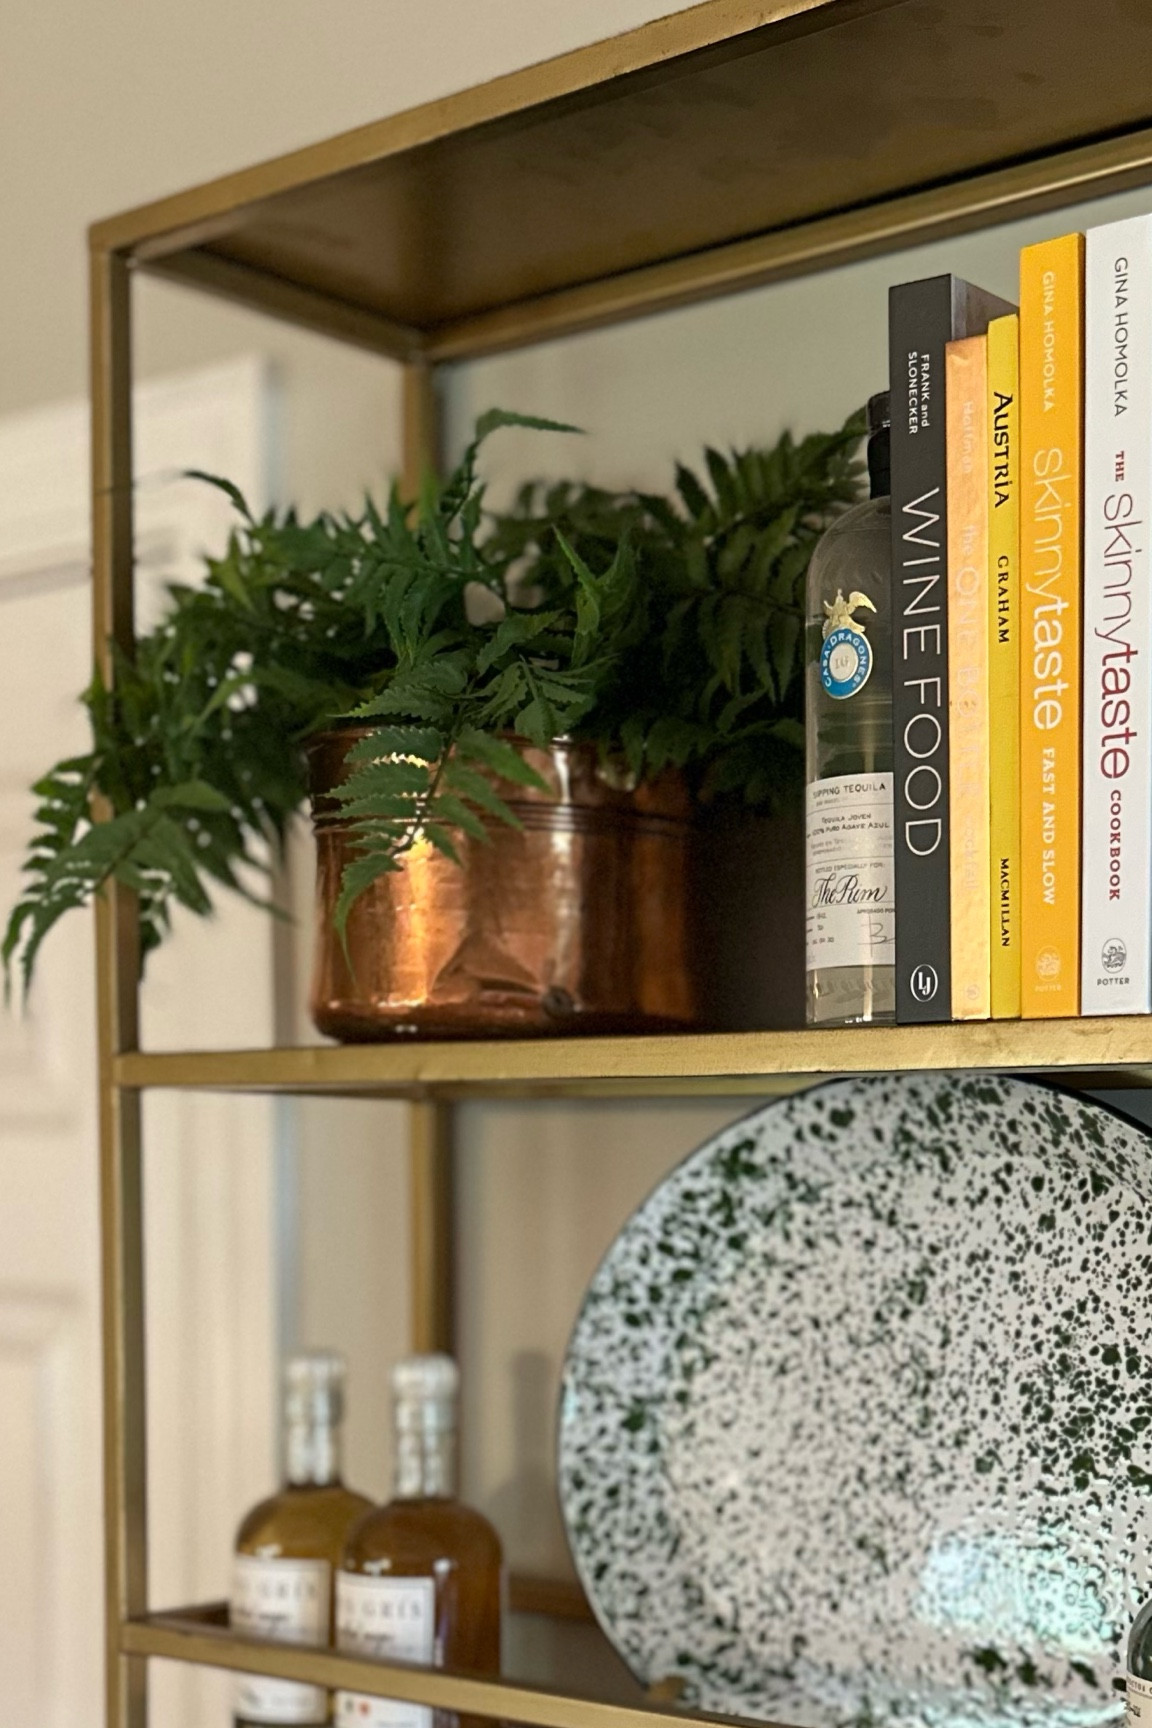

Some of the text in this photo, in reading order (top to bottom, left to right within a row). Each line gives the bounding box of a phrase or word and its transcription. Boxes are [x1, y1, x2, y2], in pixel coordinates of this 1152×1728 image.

[1042, 271, 1055, 413] GINA HOMOLKA
[1114, 257, 1129, 417] GINA HOMOLKA
[908, 351, 918, 435] SLONECKER
[920, 354, 931, 428] FRANK and
[1114, 451, 1125, 482] THE
[998, 555, 1009, 644] GRAHAM
[1025, 447, 1072, 730] Skinnytaste
[902, 487, 942, 857] WINE FOOD
[1094, 493, 1143, 779] Skinnytaste
[812, 782, 886, 799] SIPPING TEQUILA
[847, 812, 872, 822] JOVEN
[1042, 746, 1057, 905] FAST AND SLOW
[811, 872, 836, 908] The
[1109, 790, 1121, 901] COOKBOOK
[1000, 857, 1010, 948] MACMILLAN
[1097, 976, 1130, 986] POTTER
